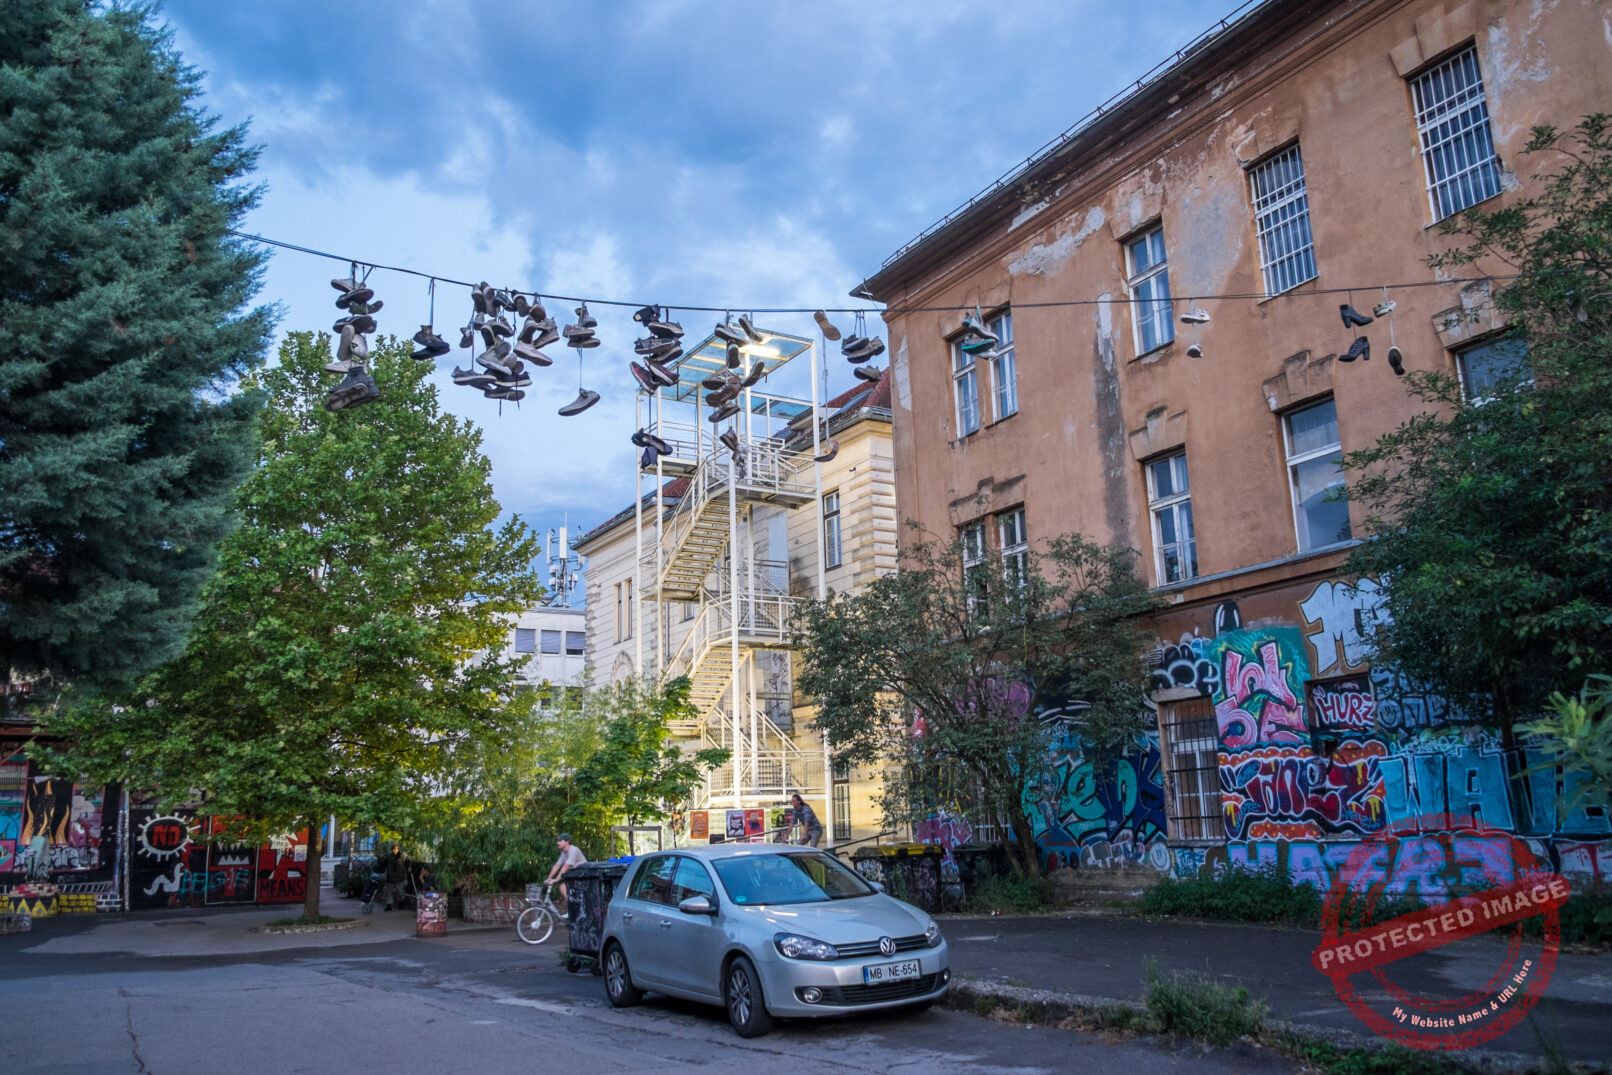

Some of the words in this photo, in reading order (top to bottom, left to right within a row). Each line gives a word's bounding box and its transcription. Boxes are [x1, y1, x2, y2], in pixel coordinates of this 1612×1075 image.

[1316, 692, 1374, 728] HURZ
[260, 879, 305, 897] MEANS
[869, 968, 883, 980] MB
[888, 963, 917, 977] NE-654
